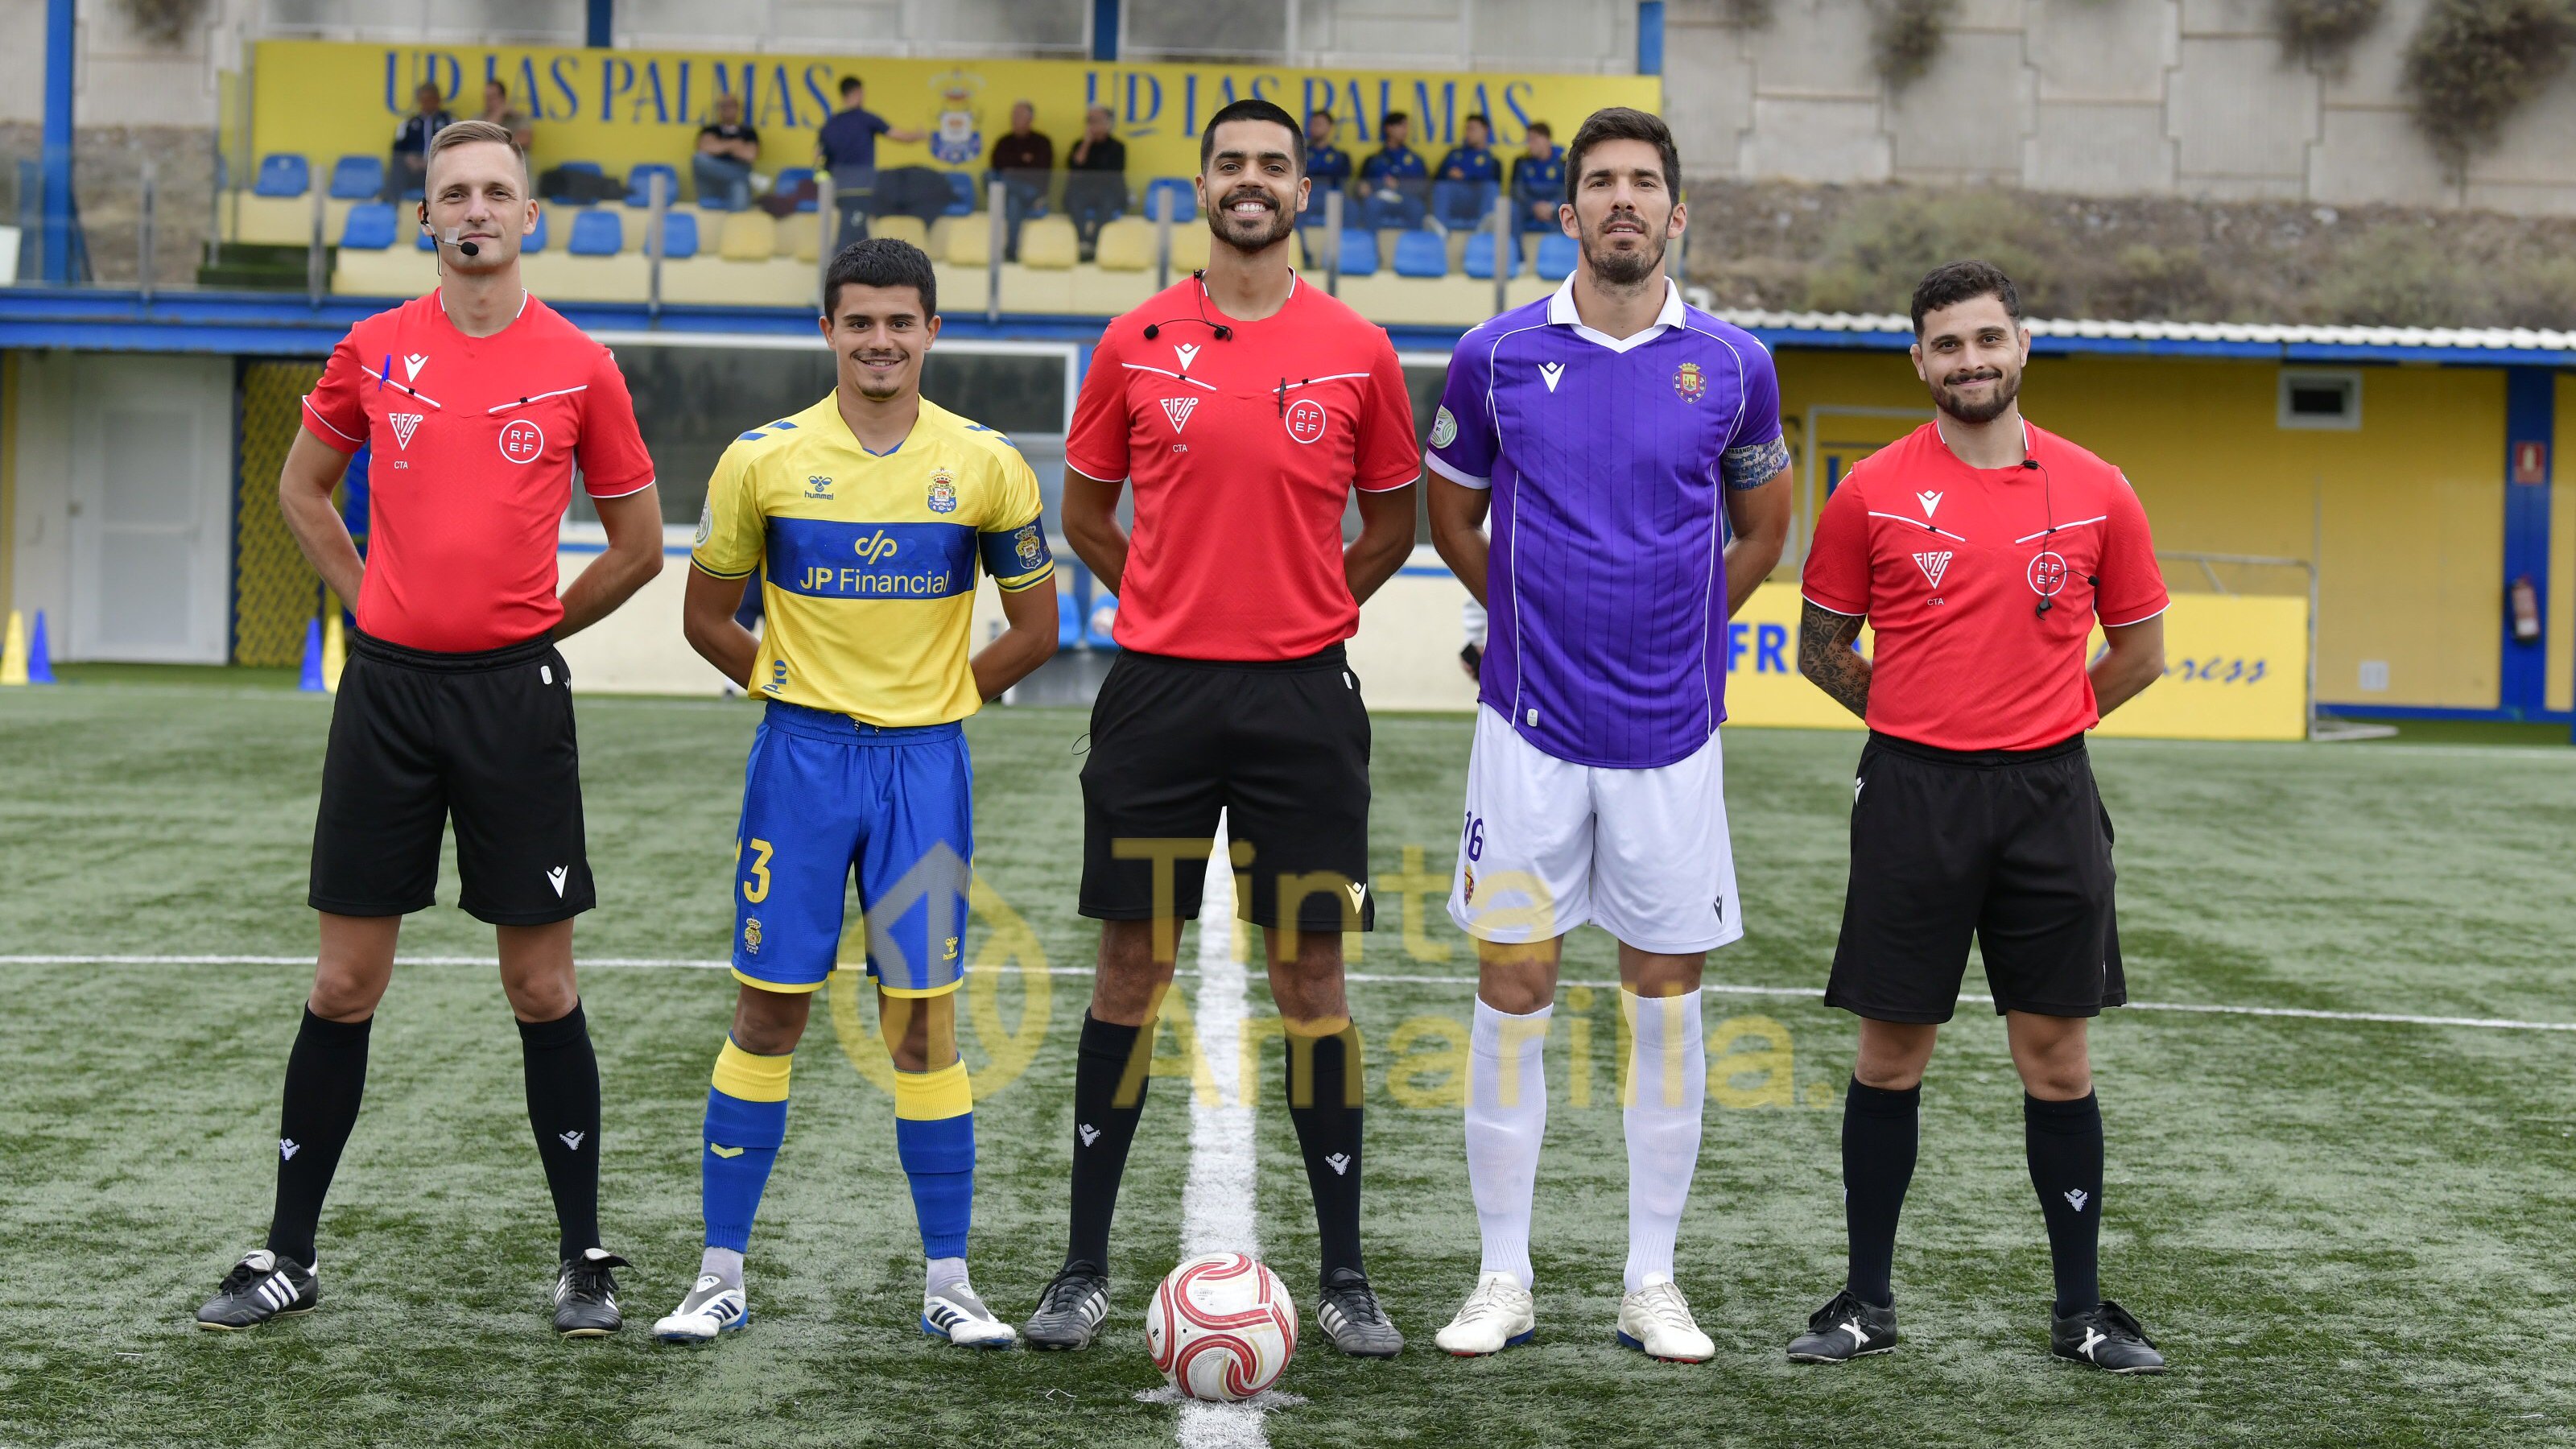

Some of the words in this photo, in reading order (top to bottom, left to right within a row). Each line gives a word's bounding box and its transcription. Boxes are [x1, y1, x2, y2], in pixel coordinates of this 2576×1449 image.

[601, 58, 832, 128] PALMAS
[1302, 76, 1533, 145] PALMAS
[1172, 444, 1188, 452] CTA
[394, 460, 409, 469] CTA
[804, 489, 834, 500] hummel
[799, 567, 833, 590] JP
[840, 568, 950, 594] Financial
[1927, 597, 1945, 606] CTA
[1464, 811, 1484, 862] 16
